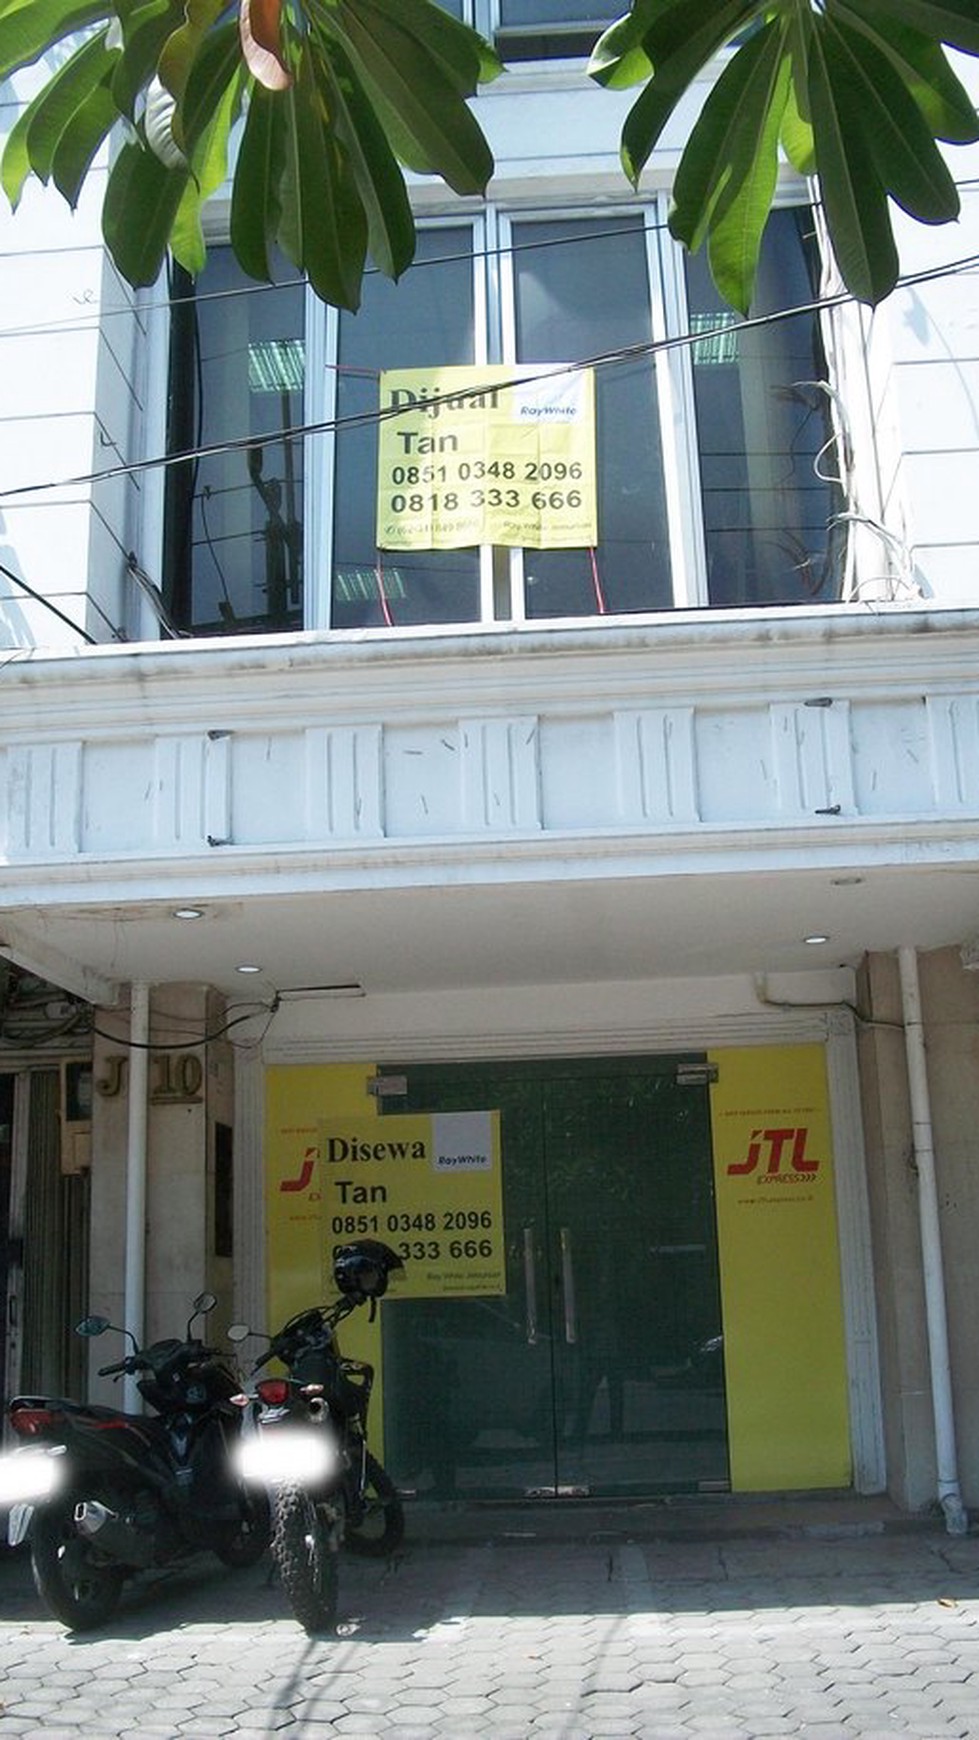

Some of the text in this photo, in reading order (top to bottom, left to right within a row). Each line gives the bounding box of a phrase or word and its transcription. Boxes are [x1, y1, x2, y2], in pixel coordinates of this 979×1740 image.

[397, 432, 458, 454] Tan
[392, 461, 582, 485] 0851 0348 2096
[391, 489, 582, 513] 0818 333 666
[97, 1054, 203, 1097] J 10
[328, 1137, 426, 1163] Disewa
[438, 1155, 487, 1166] RayWhite
[335, 1181, 387, 1204] Tan
[332, 1211, 492, 1234] 0851 0348 2096
[399, 1241, 440, 1260] 333
[449, 1239, 493, 1259] 666
